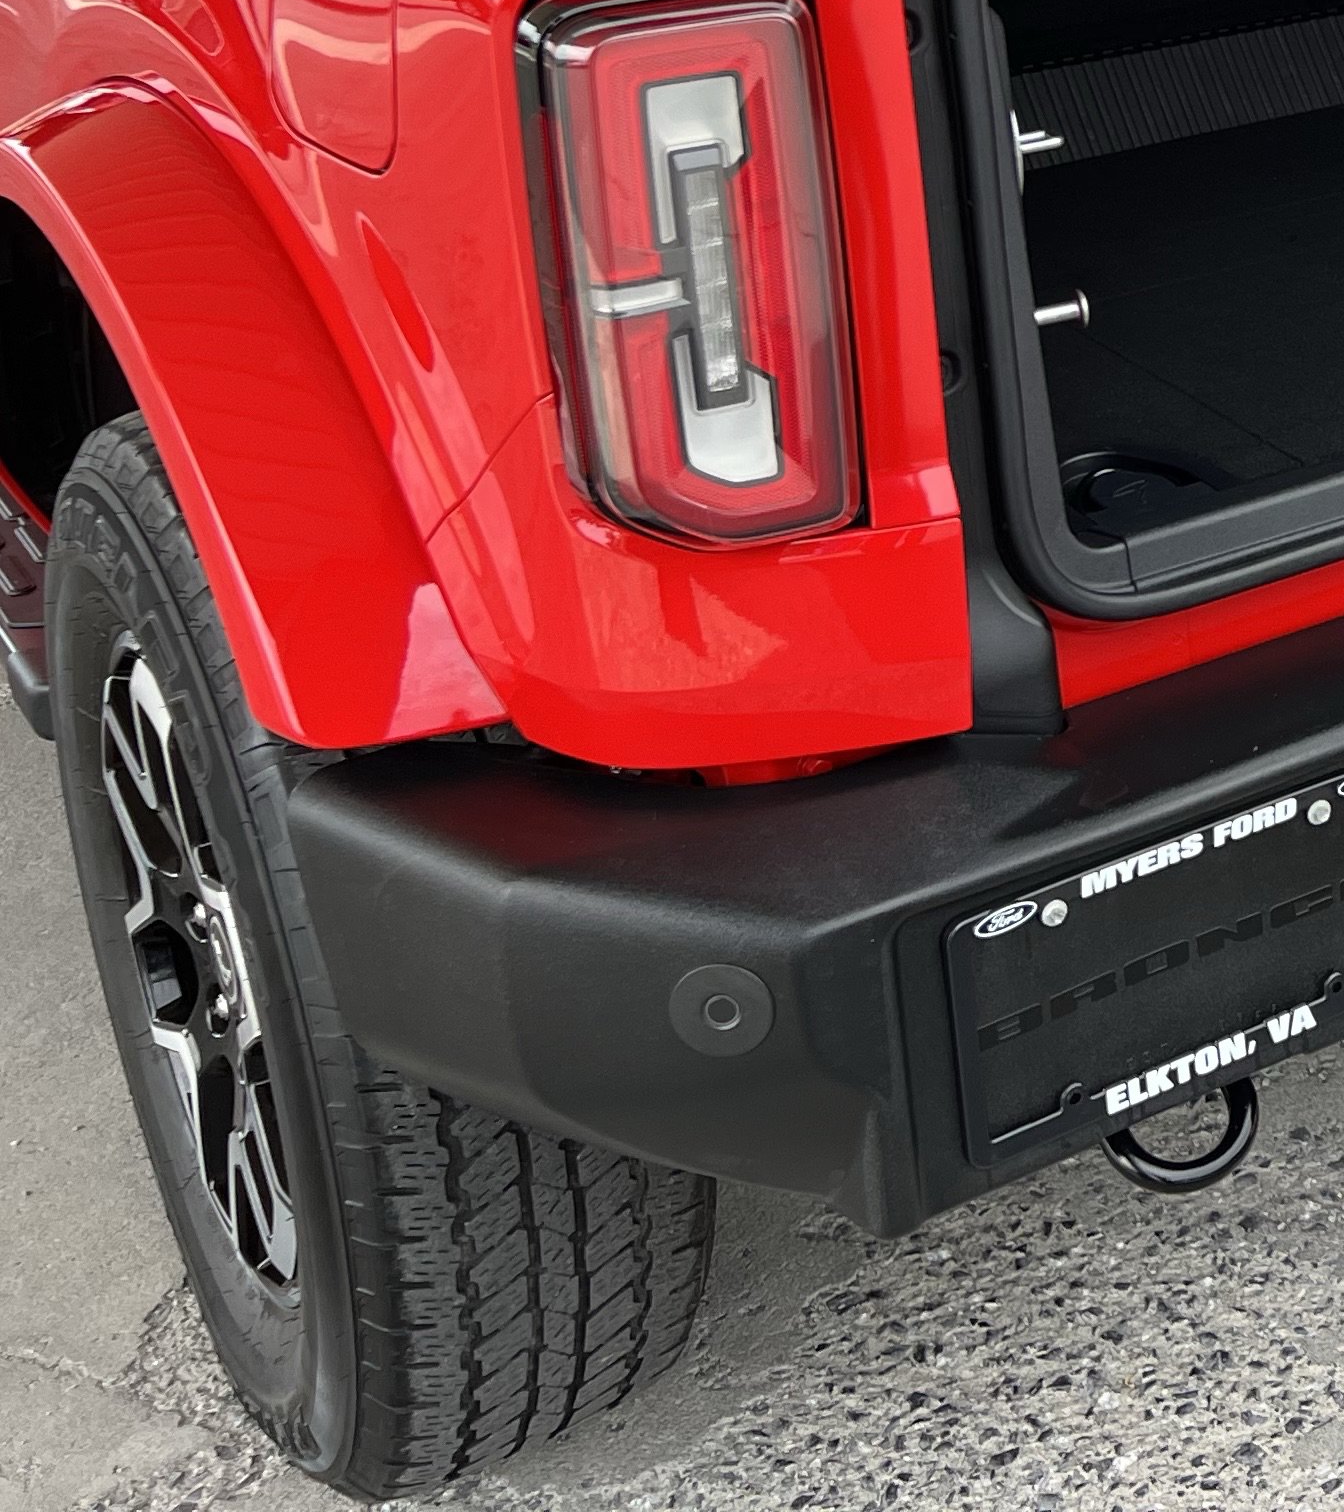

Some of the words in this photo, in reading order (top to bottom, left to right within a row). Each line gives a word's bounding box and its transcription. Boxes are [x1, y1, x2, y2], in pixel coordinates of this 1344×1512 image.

[1080, 832, 1204, 899] MYERS
[1213, 796, 1298, 848] FORD
[1105, 1030, 1258, 1116] ELKTON,
[1267, 1003, 1318, 1044] VA
